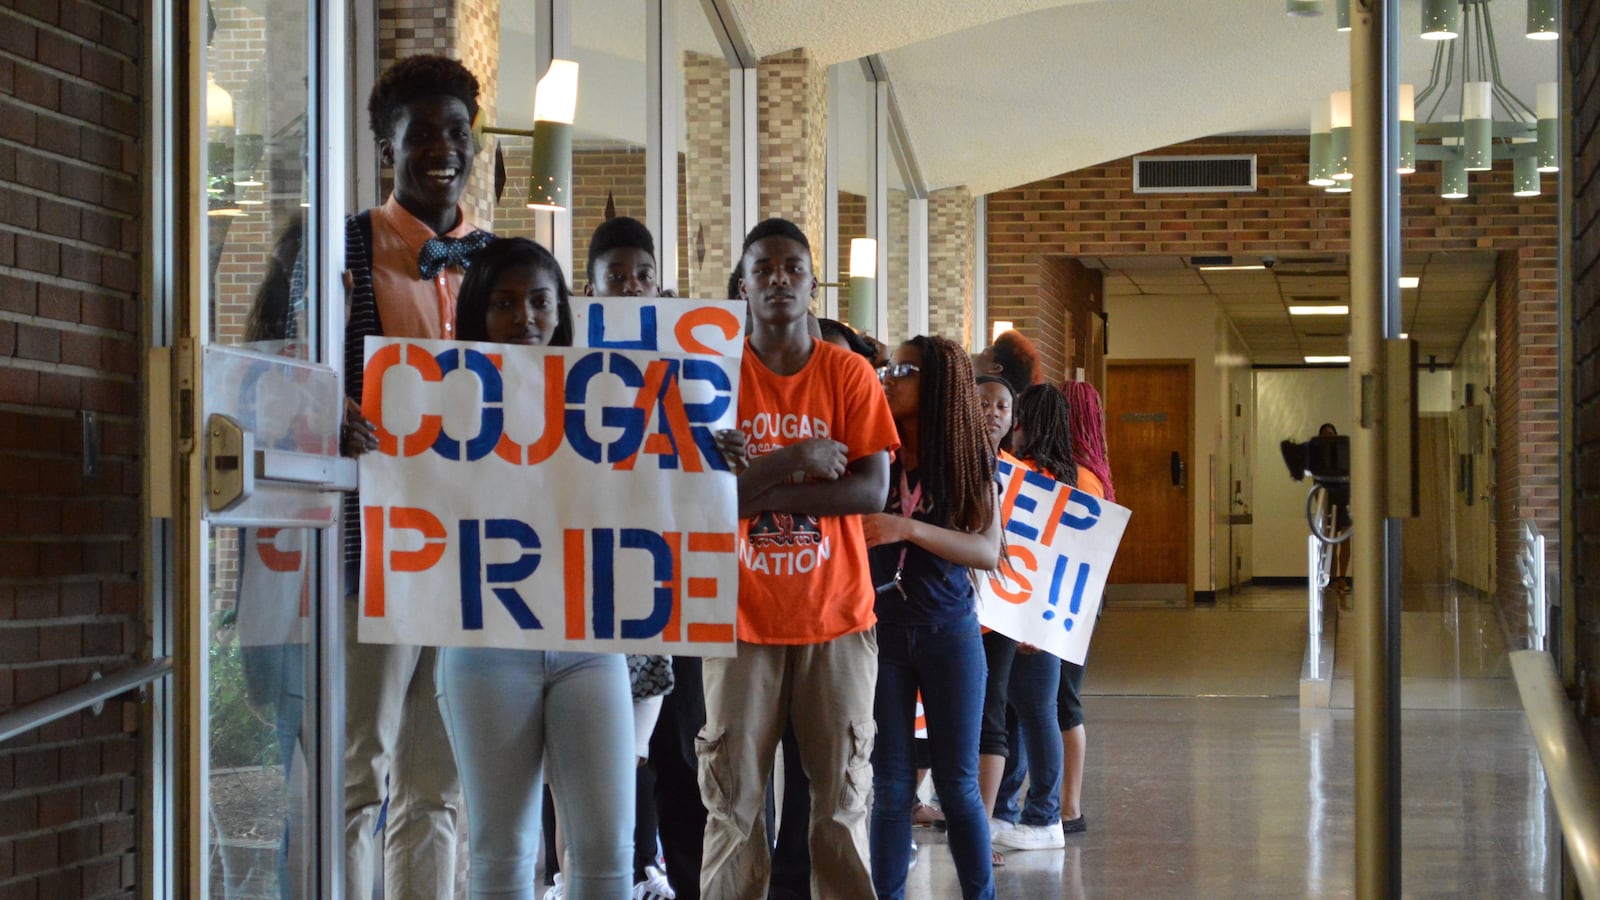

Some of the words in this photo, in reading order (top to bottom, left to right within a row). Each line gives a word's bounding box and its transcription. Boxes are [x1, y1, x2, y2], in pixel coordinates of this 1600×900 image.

[361, 343, 732, 472] COUGAR
[739, 535, 831, 576] NATION
[998, 460, 1102, 547] EP
[363, 506, 736, 643] PRIDE
